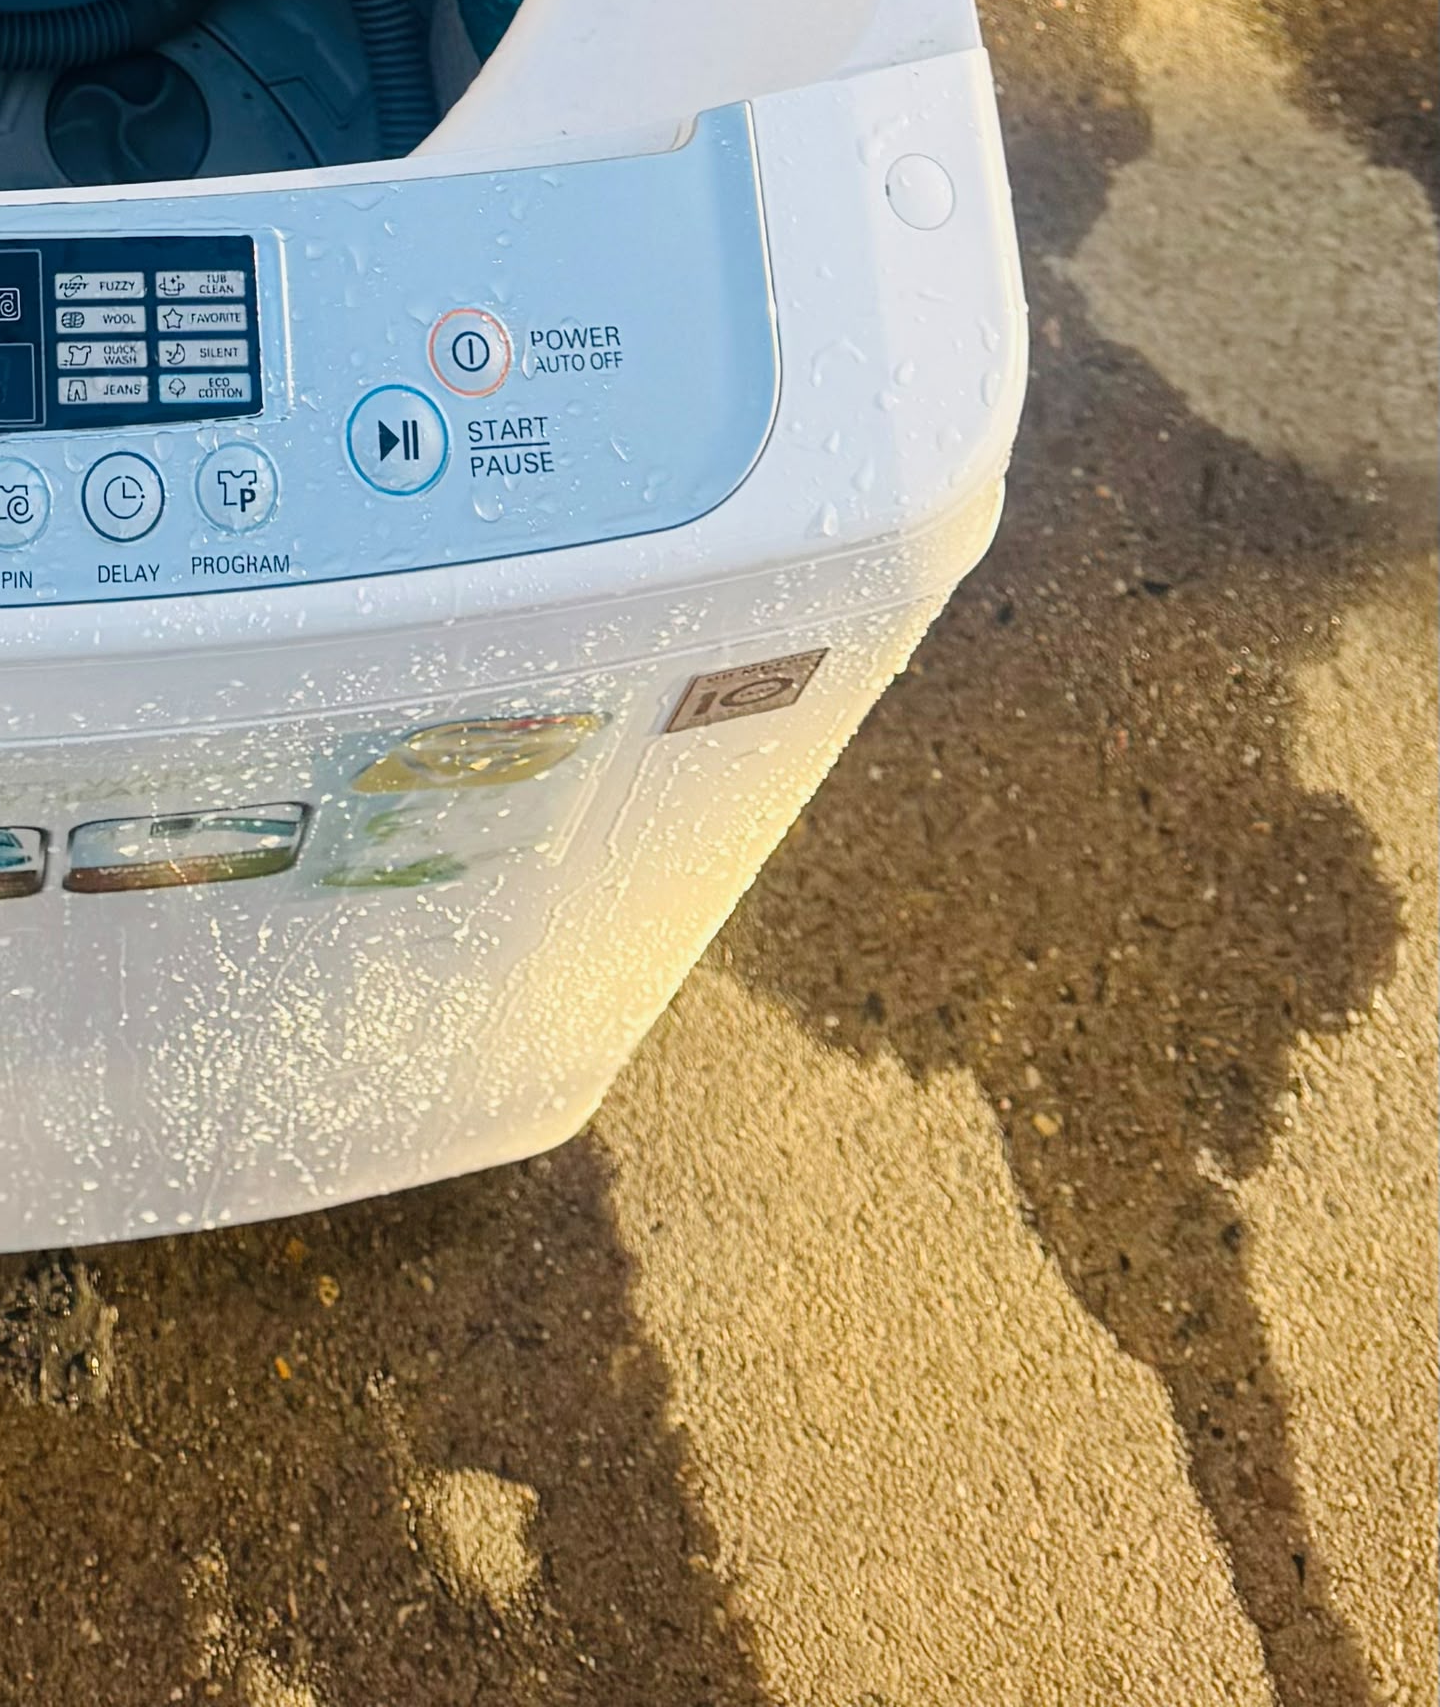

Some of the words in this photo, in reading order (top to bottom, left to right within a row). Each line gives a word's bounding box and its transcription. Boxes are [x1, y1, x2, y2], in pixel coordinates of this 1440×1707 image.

[205, 273, 227, 284] TUB
[99, 280, 136, 292] FUZZY
[199, 284, 235, 294] CLEAN
[102, 313, 137, 325] WOOL
[190, 312, 242, 324] FAVORITE
[530, 325, 621, 351] POWER
[103, 345, 137, 354] QUICK
[199, 347, 240, 358] SILENT
[103, 356, 137, 366] WASH
[534, 353, 586, 375] AUTO
[590, 351, 623, 371] OFF
[208, 377, 230, 387] ECO
[103, 384, 141, 396] JEANS
[198, 387, 243, 398] COTTON
[467, 415, 549, 443] START
[470, 450, 556, 479] PAUSE
[191, 555, 291, 576] PROGRAM
[97, 563, 161, 584] DELAY
